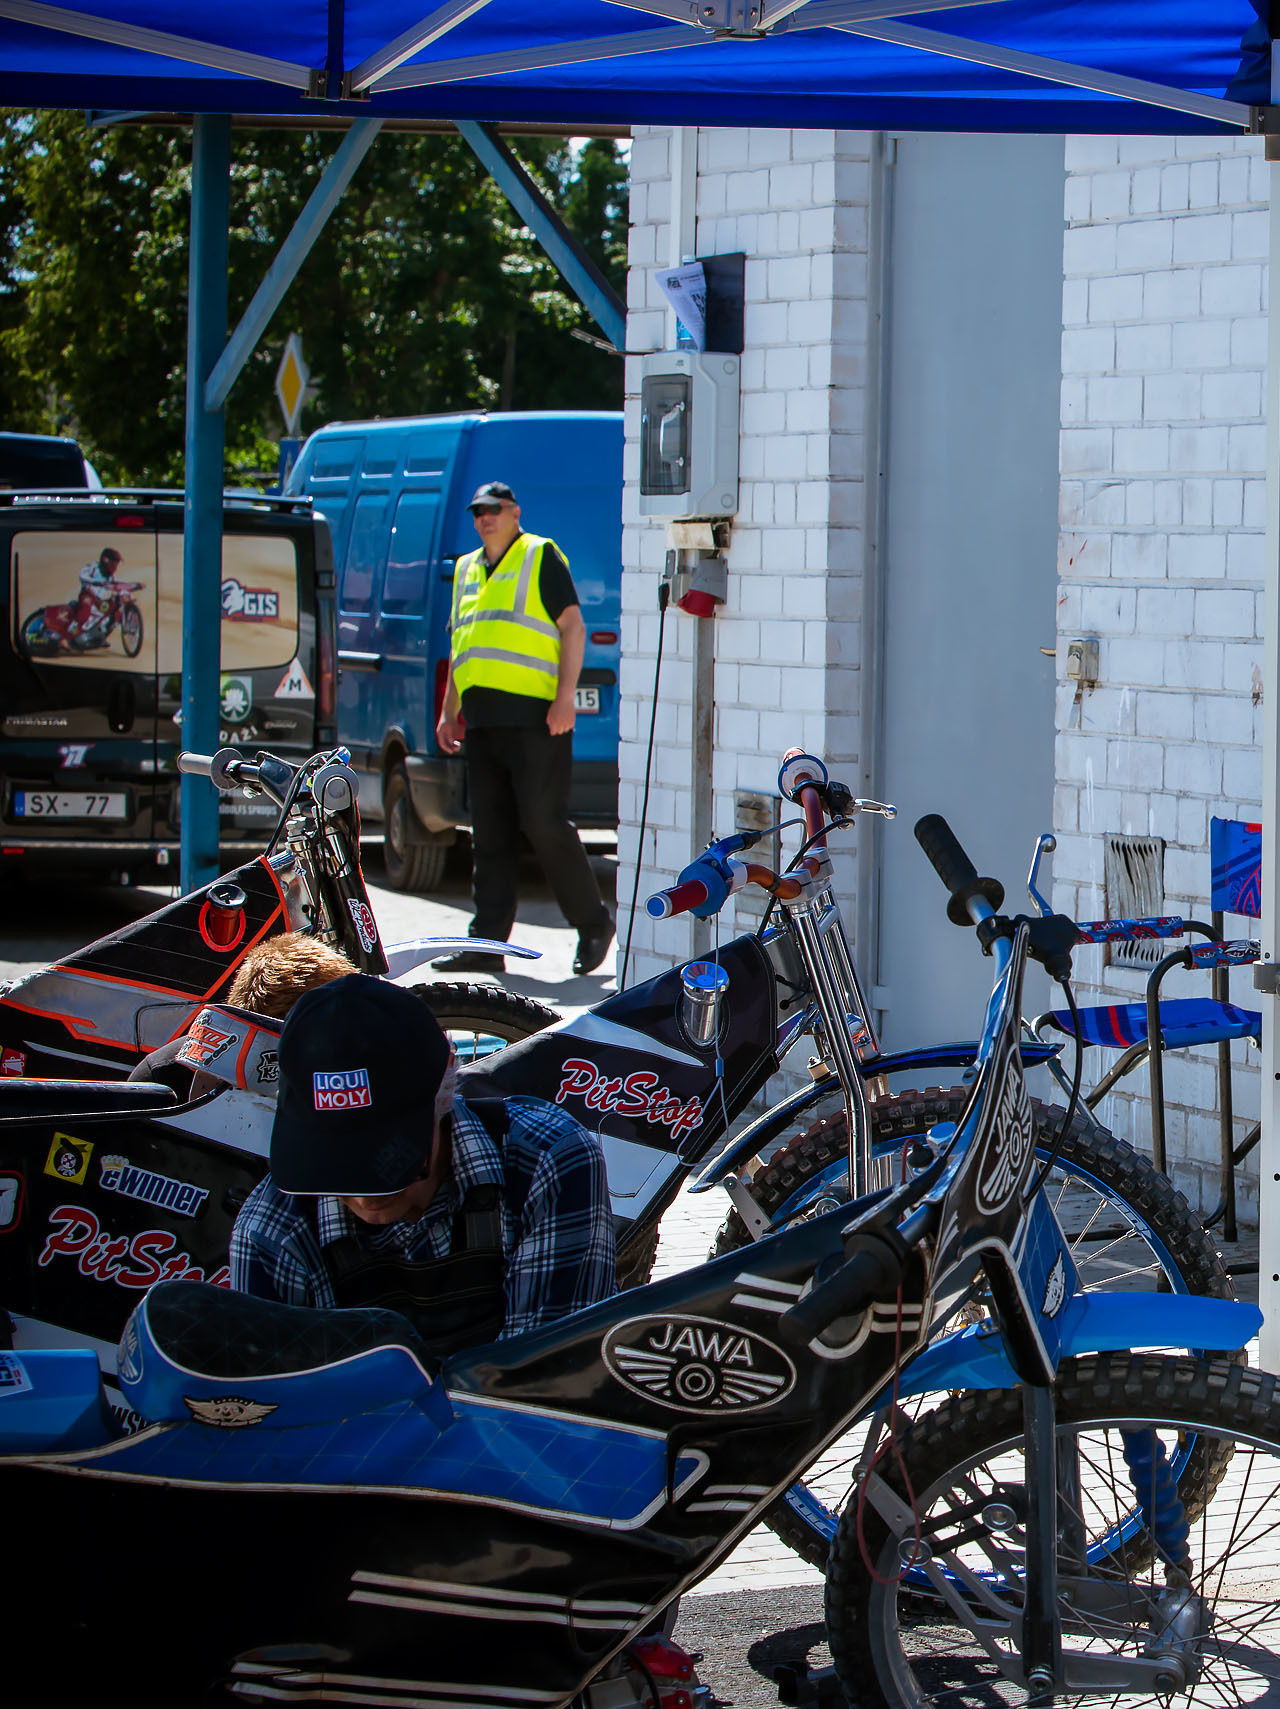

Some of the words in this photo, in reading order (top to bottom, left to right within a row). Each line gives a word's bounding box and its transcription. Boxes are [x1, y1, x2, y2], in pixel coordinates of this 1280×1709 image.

[317, 1072, 365, 1090] LIQUI
[318, 1089, 367, 1107] MOLY
[555, 1058, 703, 1139] PitStop
[649, 1323, 753, 1367] JAWA
